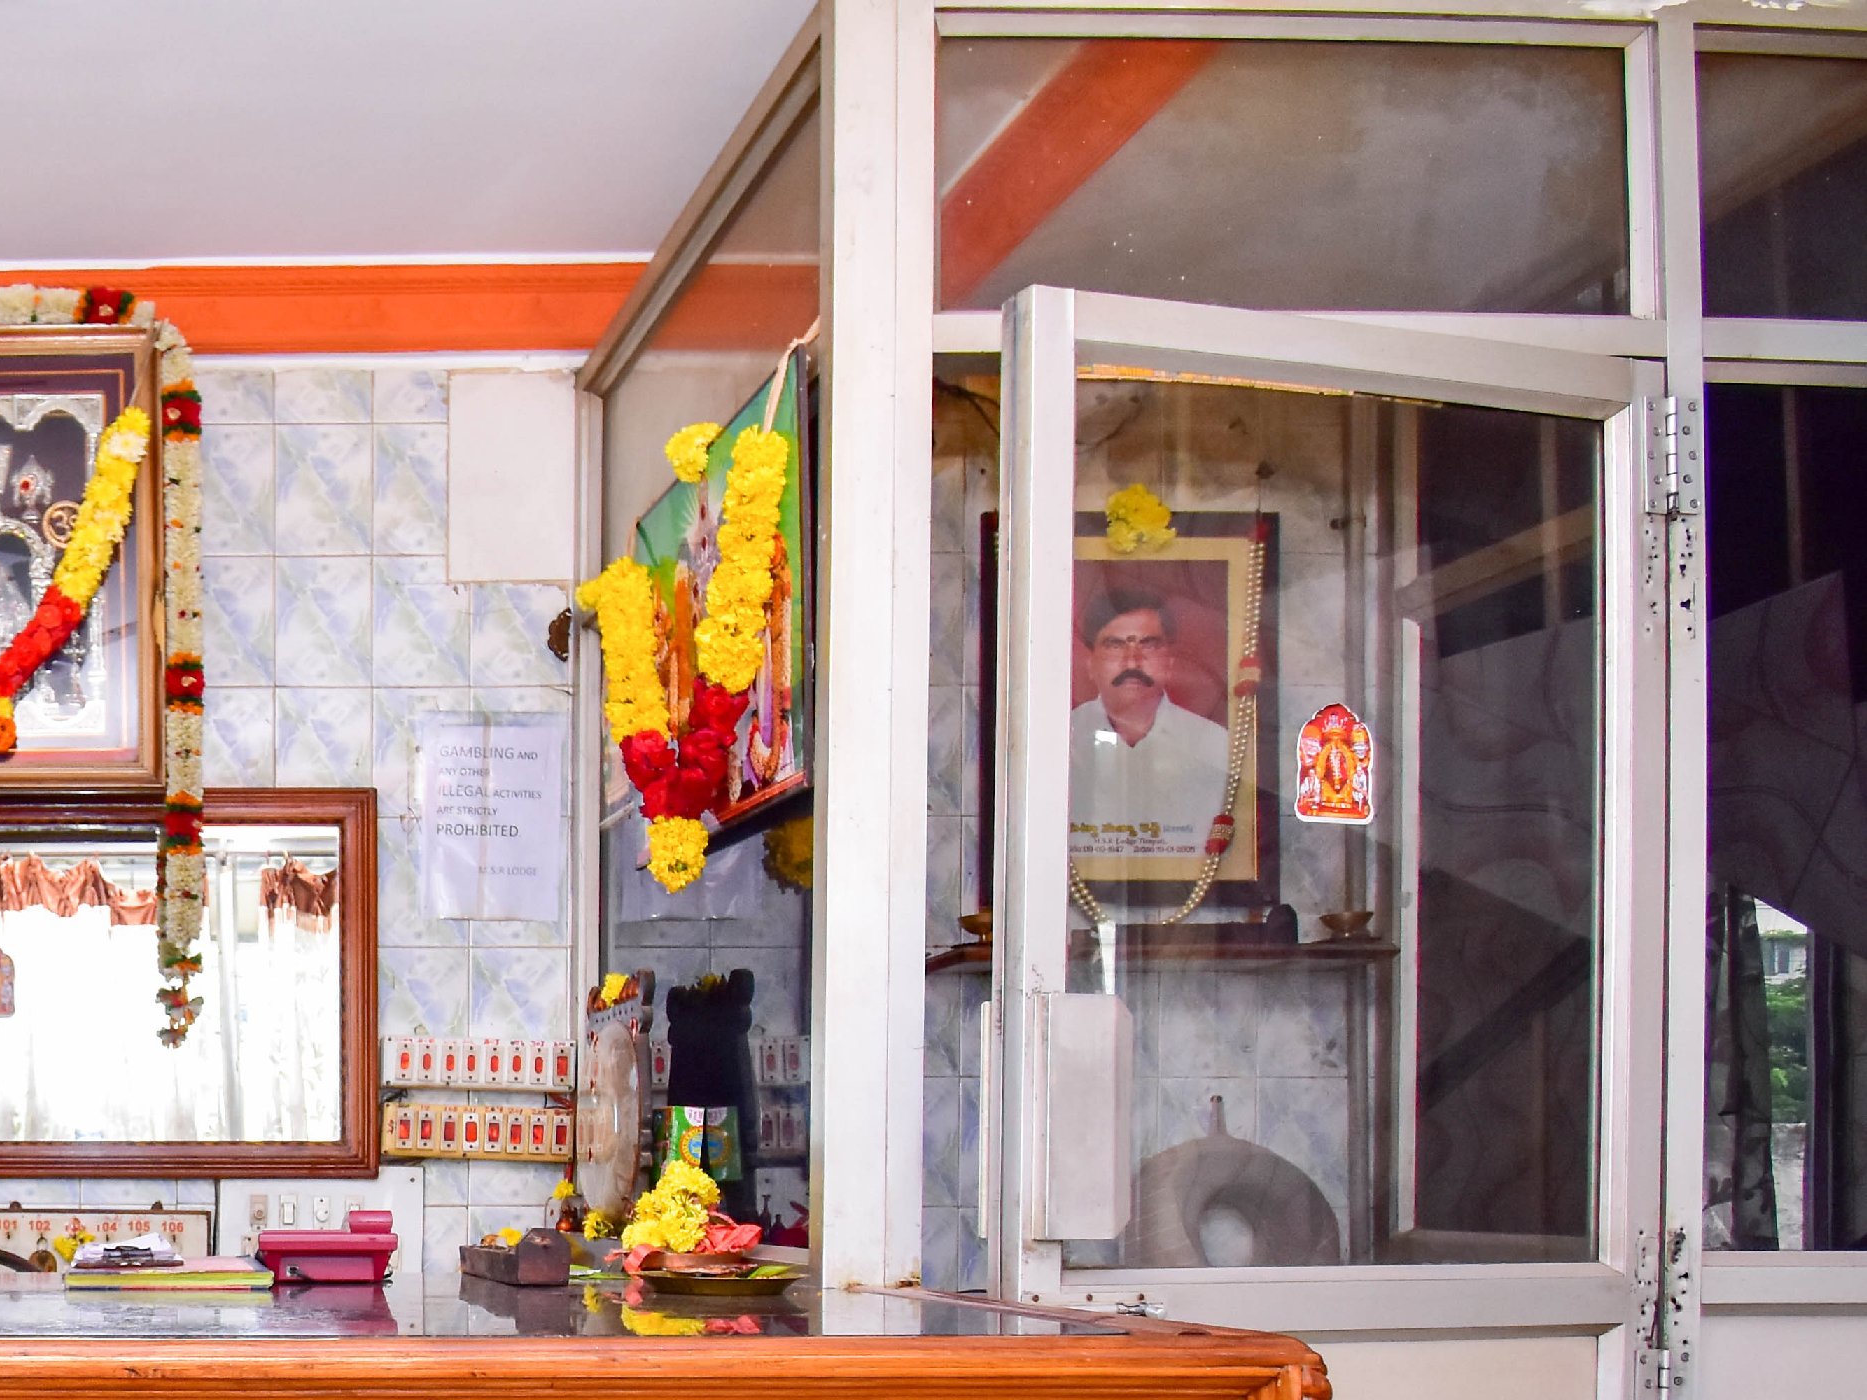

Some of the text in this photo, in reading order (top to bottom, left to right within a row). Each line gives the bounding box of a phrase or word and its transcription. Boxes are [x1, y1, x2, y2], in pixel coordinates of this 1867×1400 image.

[439, 746, 539, 760] GAMBLING AND
[438, 768, 490, 777] ANY OTHER
[438, 784, 542, 799] ILLEGAL ACTIVITIES
[456, 806, 498, 816] STRICTLY
[29, 1219, 51, 1231] 102
[128, 1220, 150, 1232] 105
[161, 1221, 184, 1233] 106
